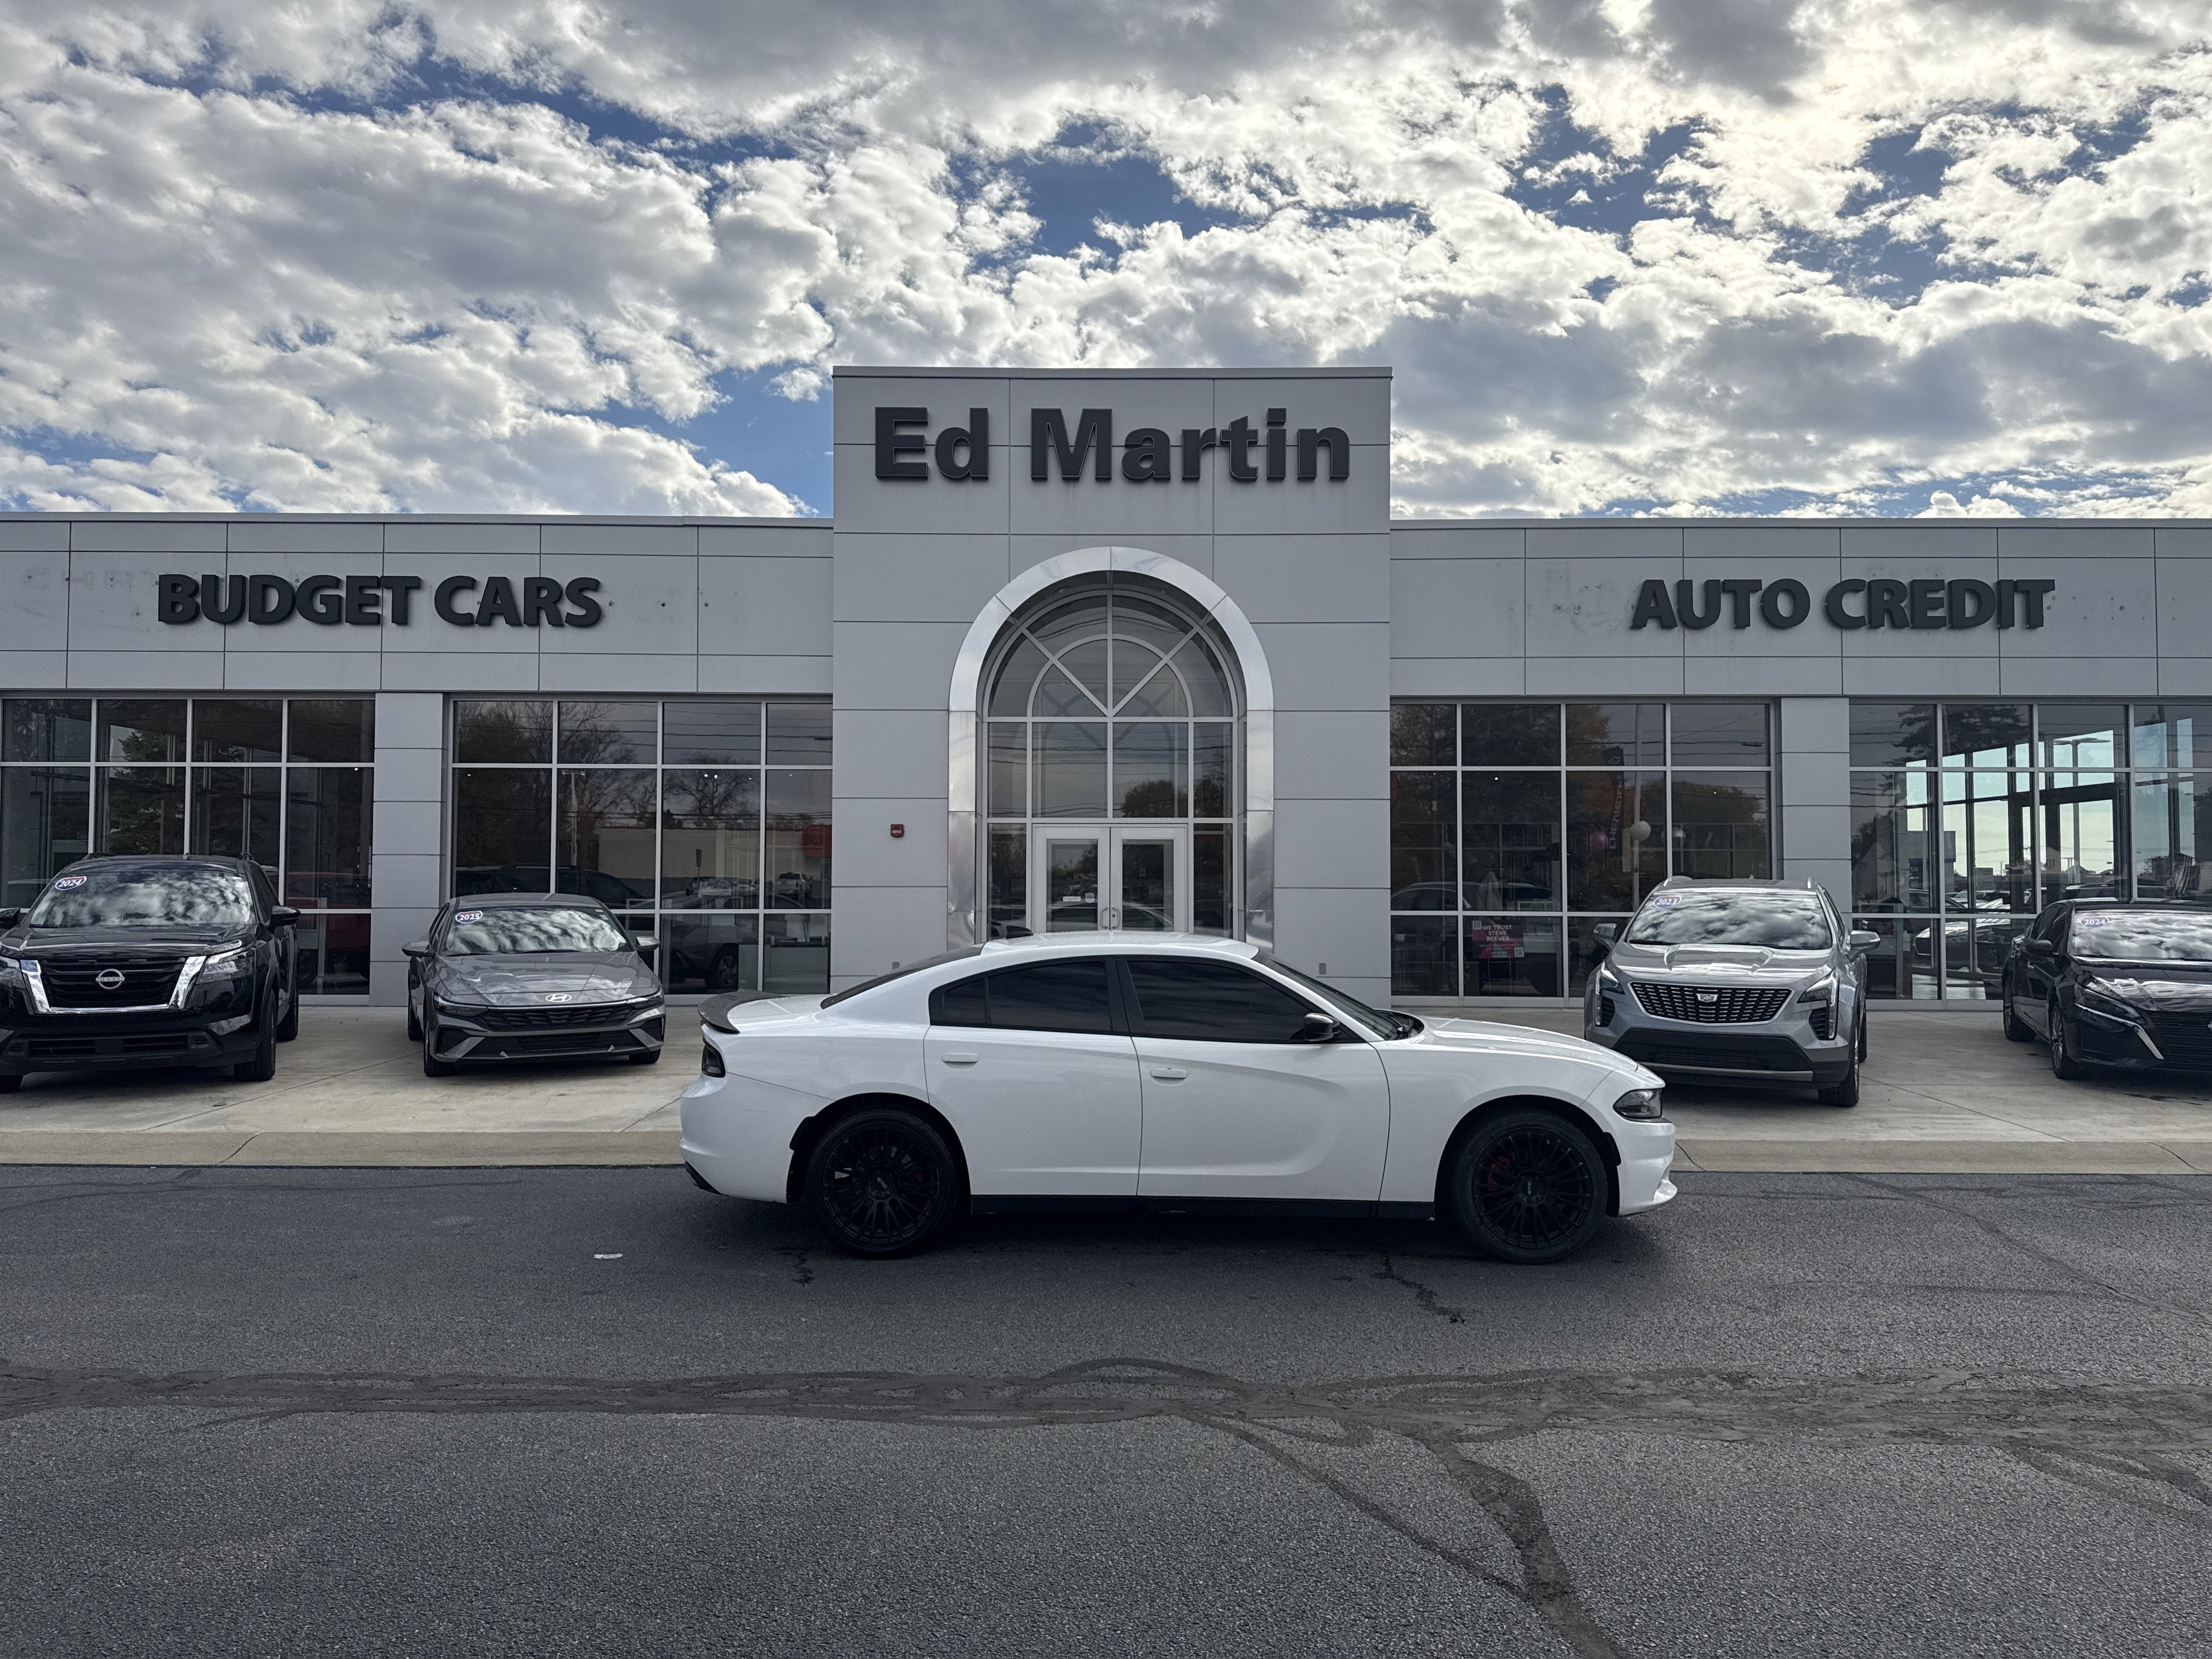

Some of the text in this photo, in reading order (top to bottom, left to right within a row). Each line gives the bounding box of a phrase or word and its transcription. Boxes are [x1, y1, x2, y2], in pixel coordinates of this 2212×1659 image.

[874, 406, 1350, 481] Ed Martin
[158, 574, 602, 628] BUDGET CARS
[1629, 578, 2056, 630] AUTO CREDIT
[57, 879, 82, 887] 2024
